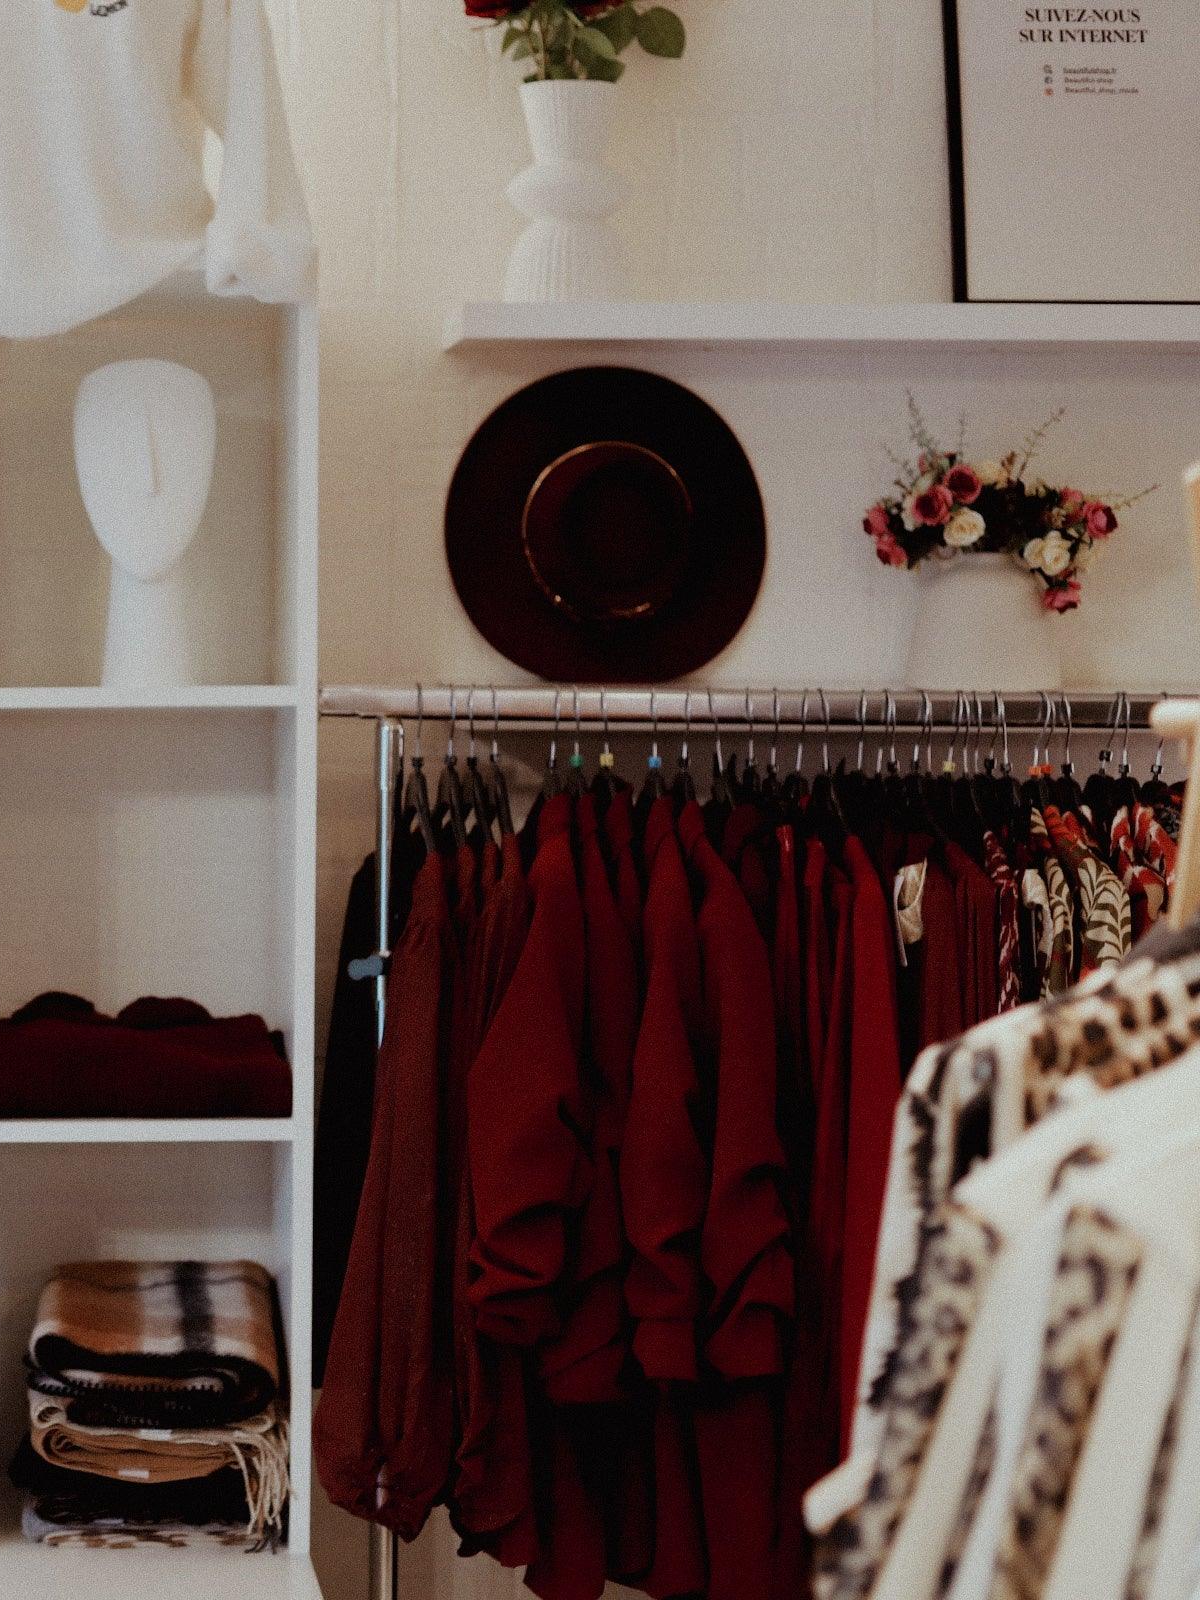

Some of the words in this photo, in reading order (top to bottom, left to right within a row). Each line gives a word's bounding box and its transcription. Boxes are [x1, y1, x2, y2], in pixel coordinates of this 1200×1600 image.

[1025, 8, 1141, 23] SUIVEZ-NOUS
[1019, 29, 1053, 43] SUR
[1060, 29, 1148, 43] INTERNET
